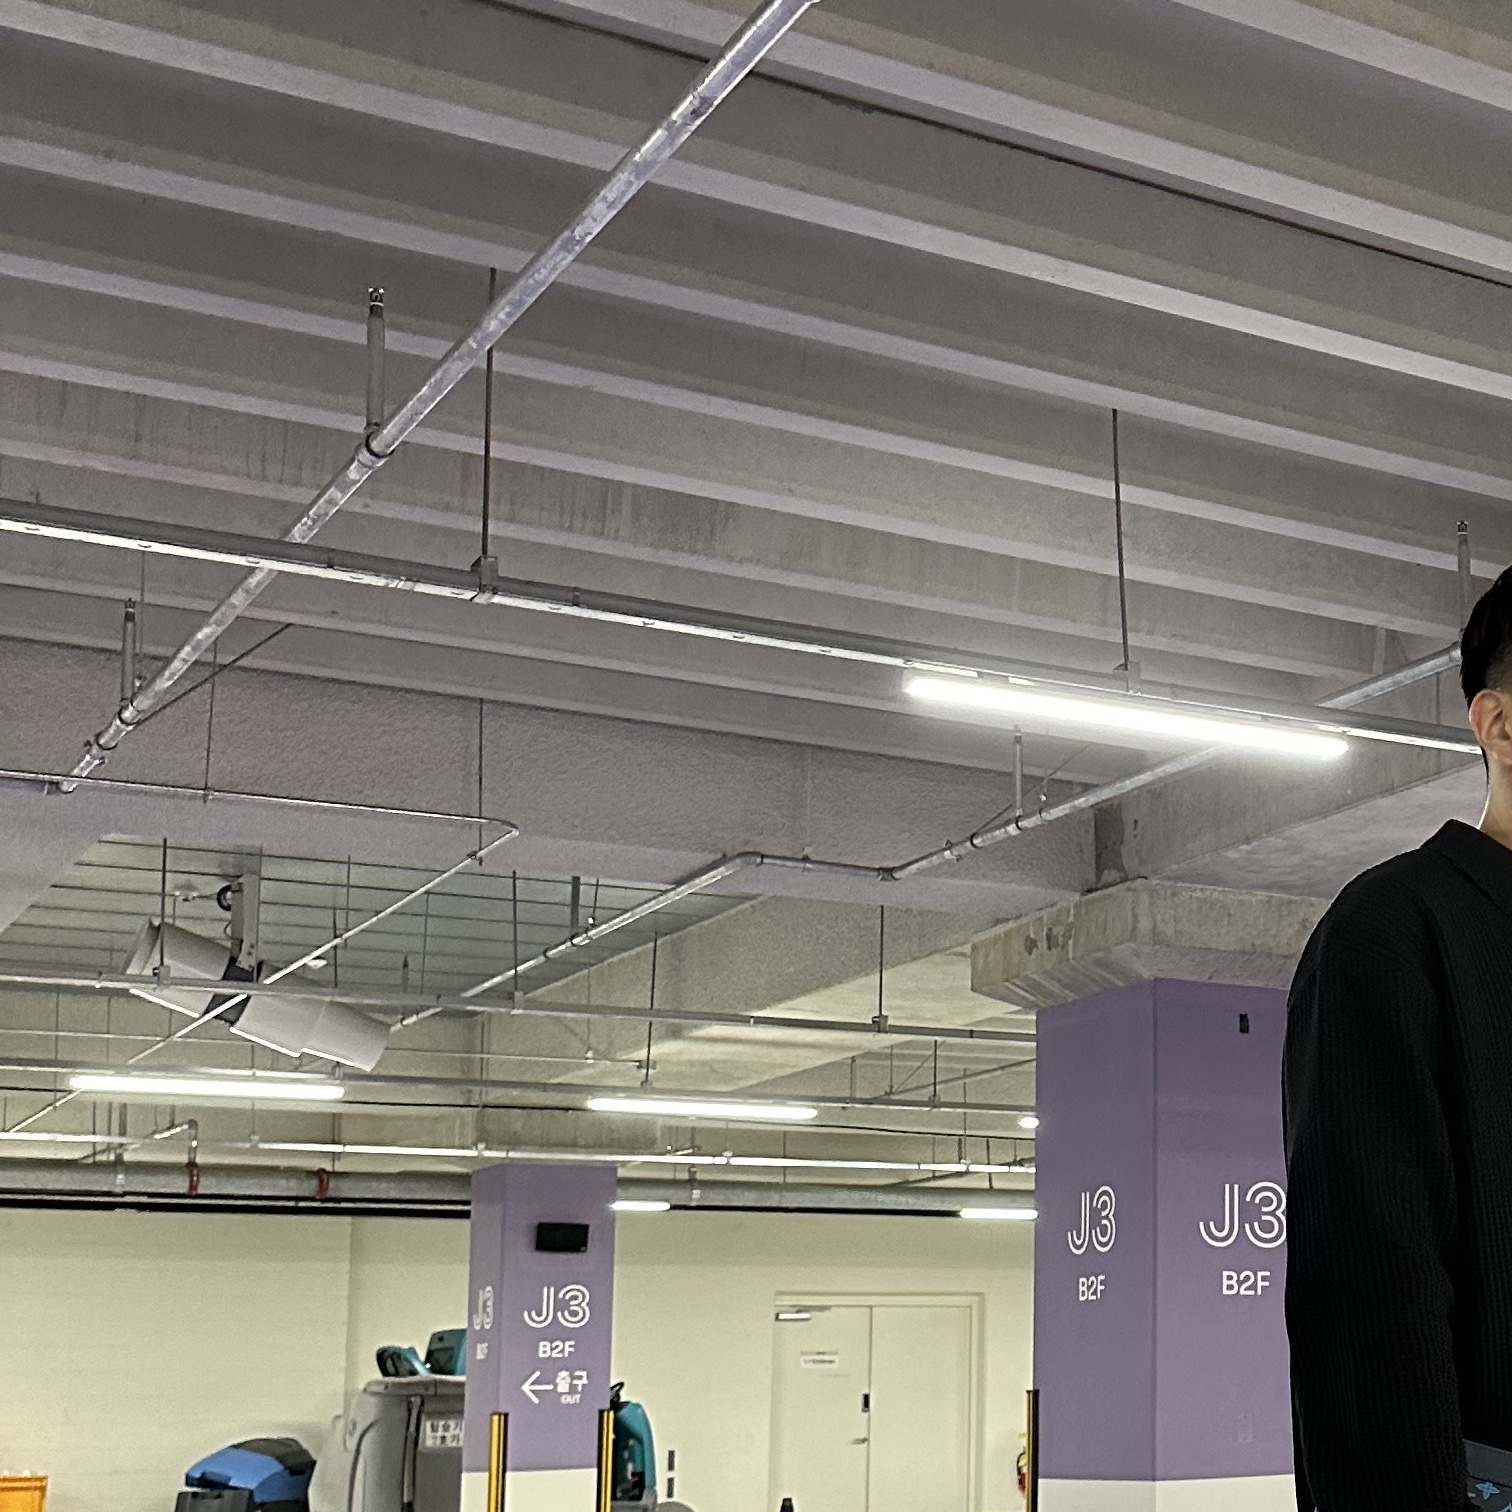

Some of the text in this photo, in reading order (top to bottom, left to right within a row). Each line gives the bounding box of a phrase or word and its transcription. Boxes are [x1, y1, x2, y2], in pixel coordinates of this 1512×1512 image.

[1067, 1185, 1117, 1255] J3
[1198, 1181, 1287, 1249] J3
[1078, 1275, 1106, 1301] B2F
[1221, 1270, 1271, 1296] B2F
[523, 1284, 591, 1328] J3
[538, 1340, 576, 1358] B2F
[555, 1370, 589, 1393] 출구
